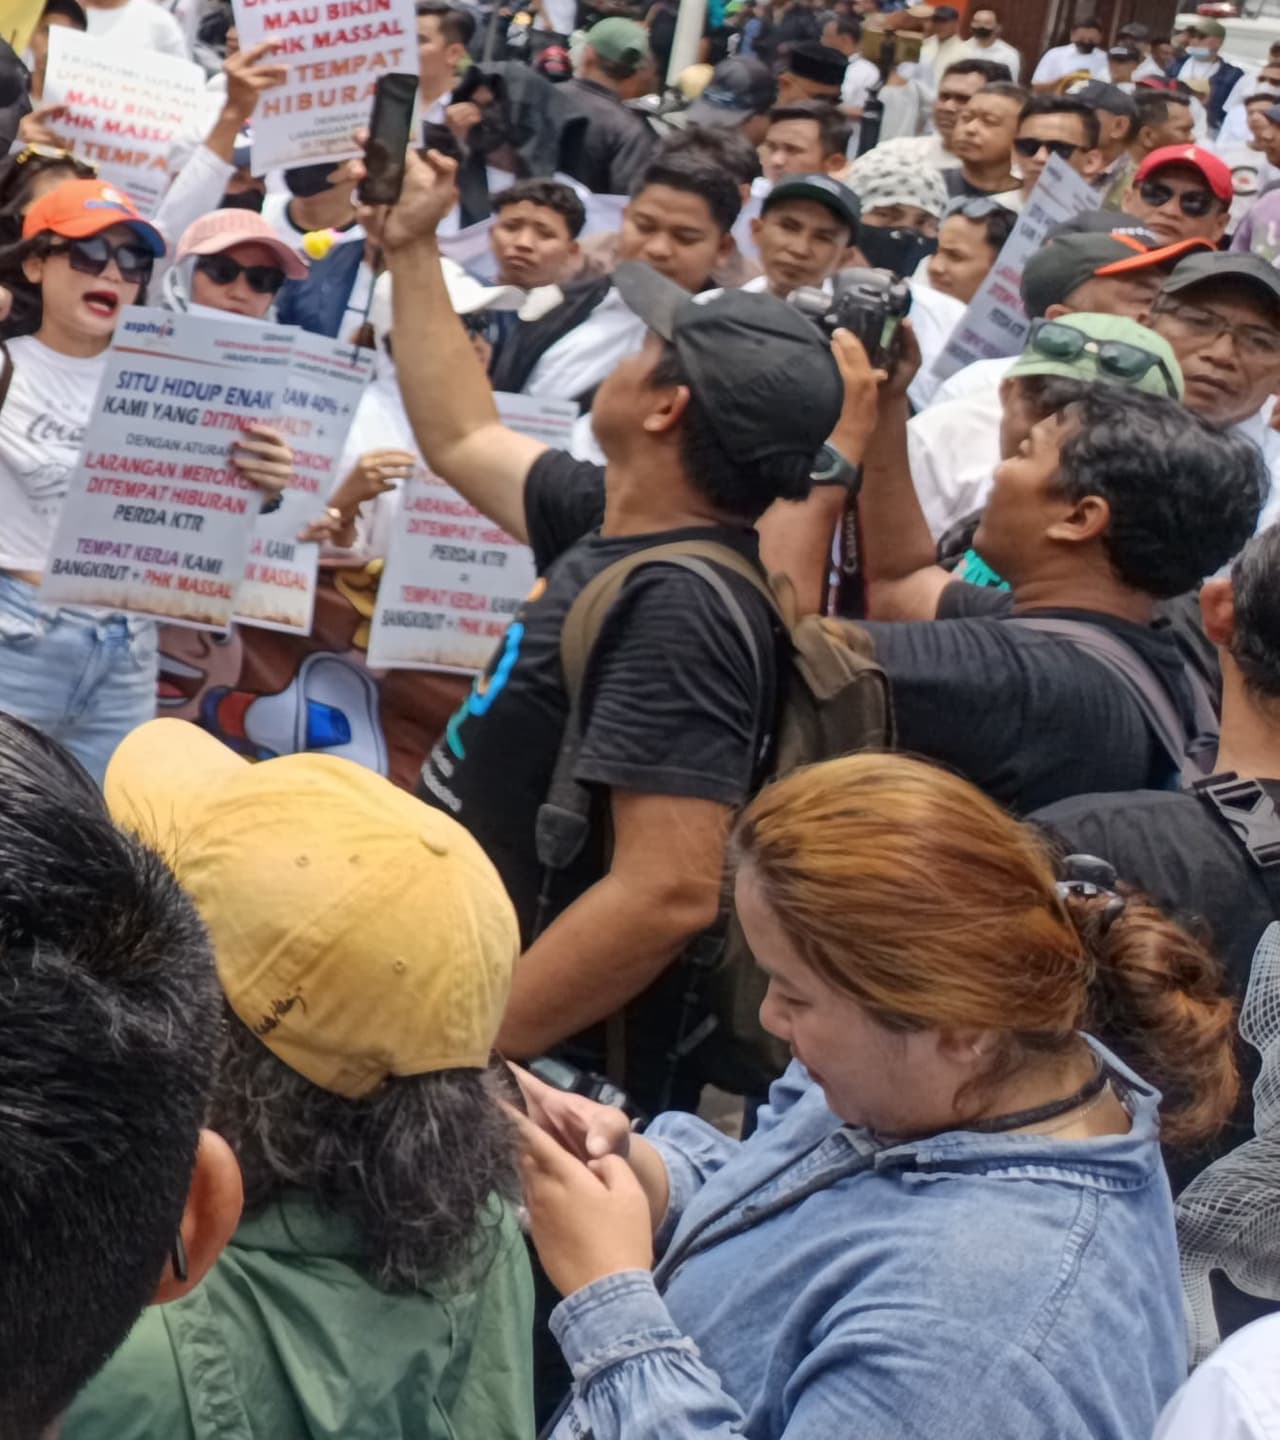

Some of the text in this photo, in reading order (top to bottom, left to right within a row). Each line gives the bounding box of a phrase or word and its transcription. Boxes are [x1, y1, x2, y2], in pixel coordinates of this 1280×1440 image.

[263, 7, 319, 32] MAU
[271, 19, 404, 56] HK MASSAL
[296, 48, 404, 82] TEMPAT
[262, 81, 377, 118] HIBURA
[85, 141, 169, 172] TEMPA
[116, 370, 158, 393] SITU
[161, 377, 222, 404] HIDUP
[103, 395, 149, 418] KAMI
[150, 402, 199, 426] YANG
[85, 453, 176, 478] LARANGAN
[86, 476, 248, 514] DITEMPAT HIBURAN
[113, 505, 204, 532] PERDA KTR
[52, 559, 129, 581] BANGKRUT
[76, 537, 223, 575] TEMPAT KERJA KAMI
